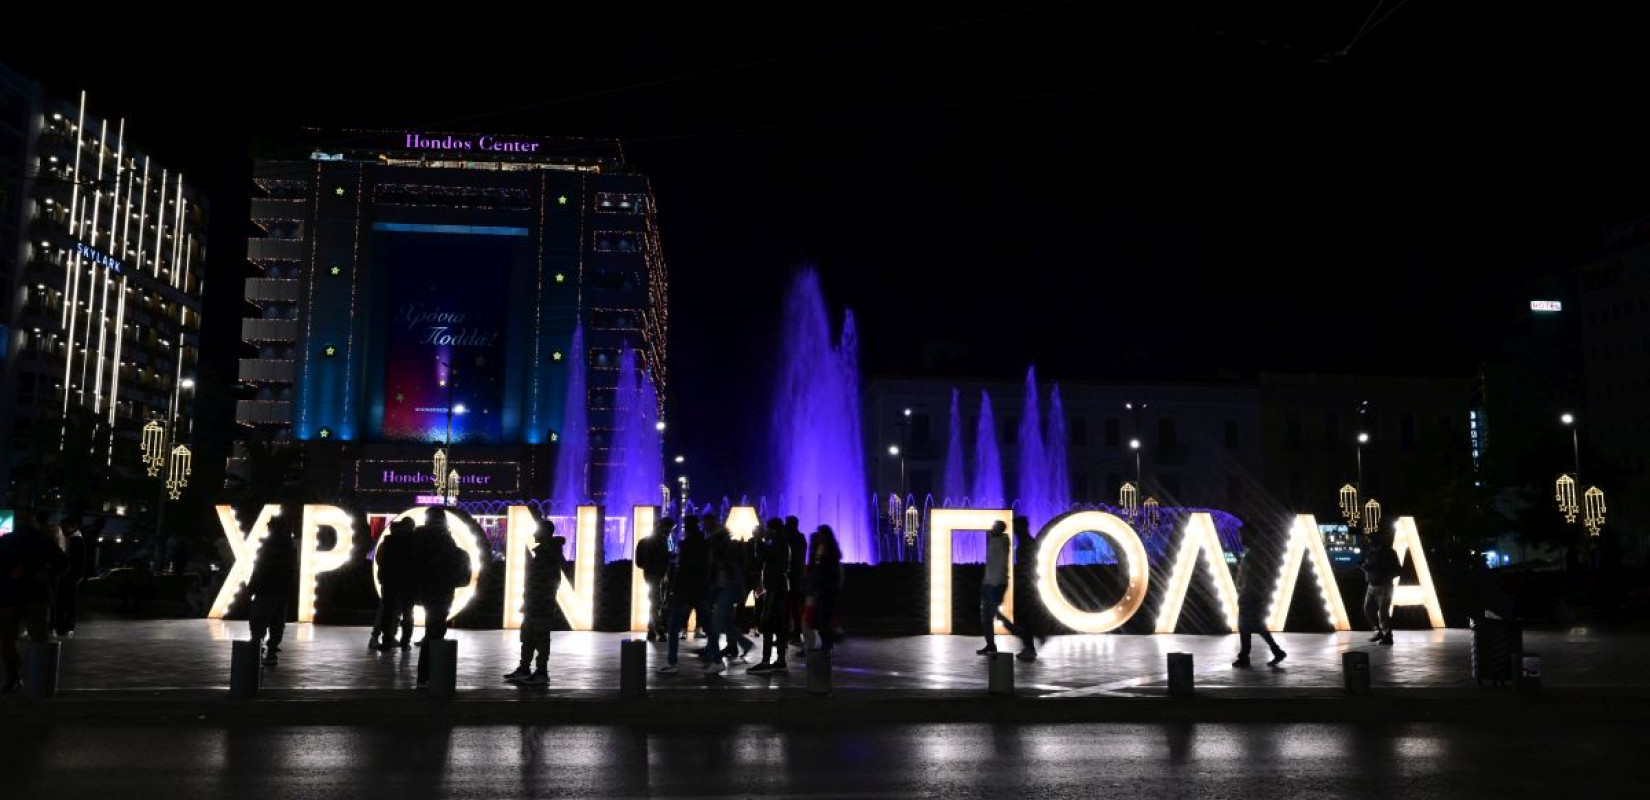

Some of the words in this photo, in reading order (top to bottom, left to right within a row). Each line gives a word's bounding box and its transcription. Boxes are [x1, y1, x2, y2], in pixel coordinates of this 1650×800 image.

[405, 133, 473, 151] Hondos
[479, 136, 540, 153] Center
[76, 242, 122, 273] SKYLARK
[449, 472, 491, 485] enter
